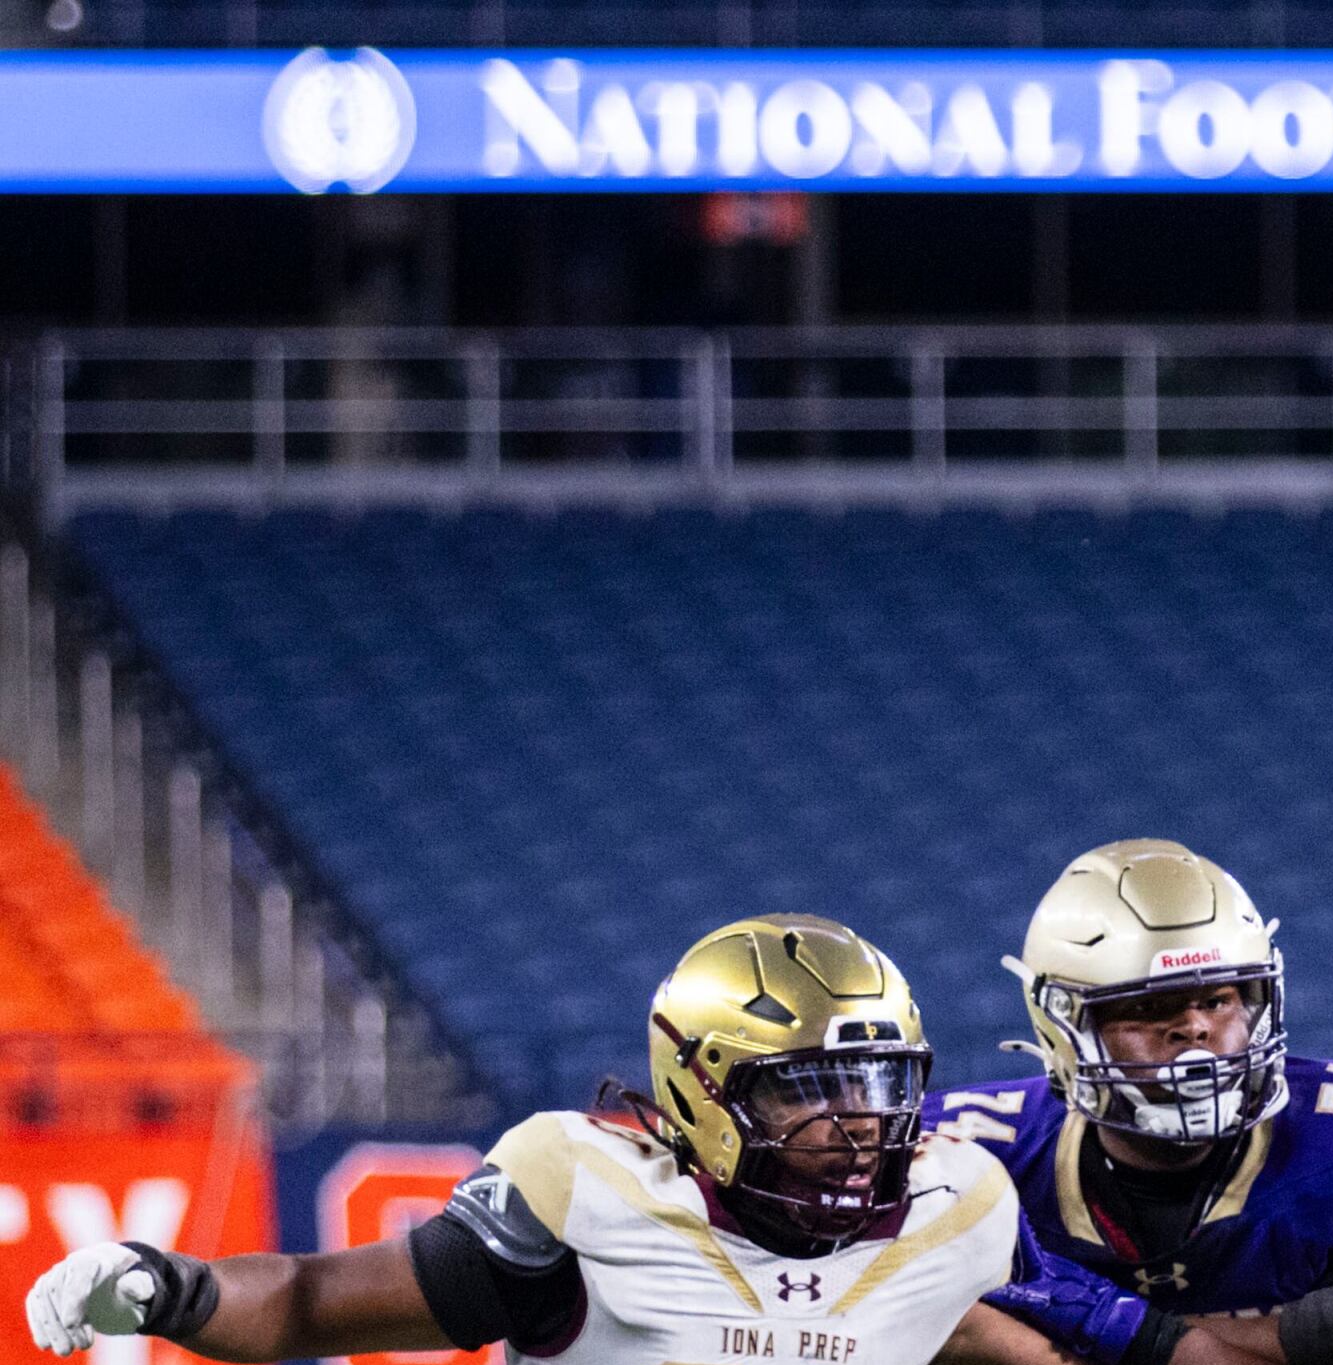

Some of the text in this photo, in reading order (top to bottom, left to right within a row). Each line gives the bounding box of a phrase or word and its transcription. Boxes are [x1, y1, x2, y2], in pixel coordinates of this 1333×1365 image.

[482, 57, 1082, 180] NATIONAL
[1161, 948, 1221, 968] Riddell
[721, 1326, 858, 1364] IONA PREP
